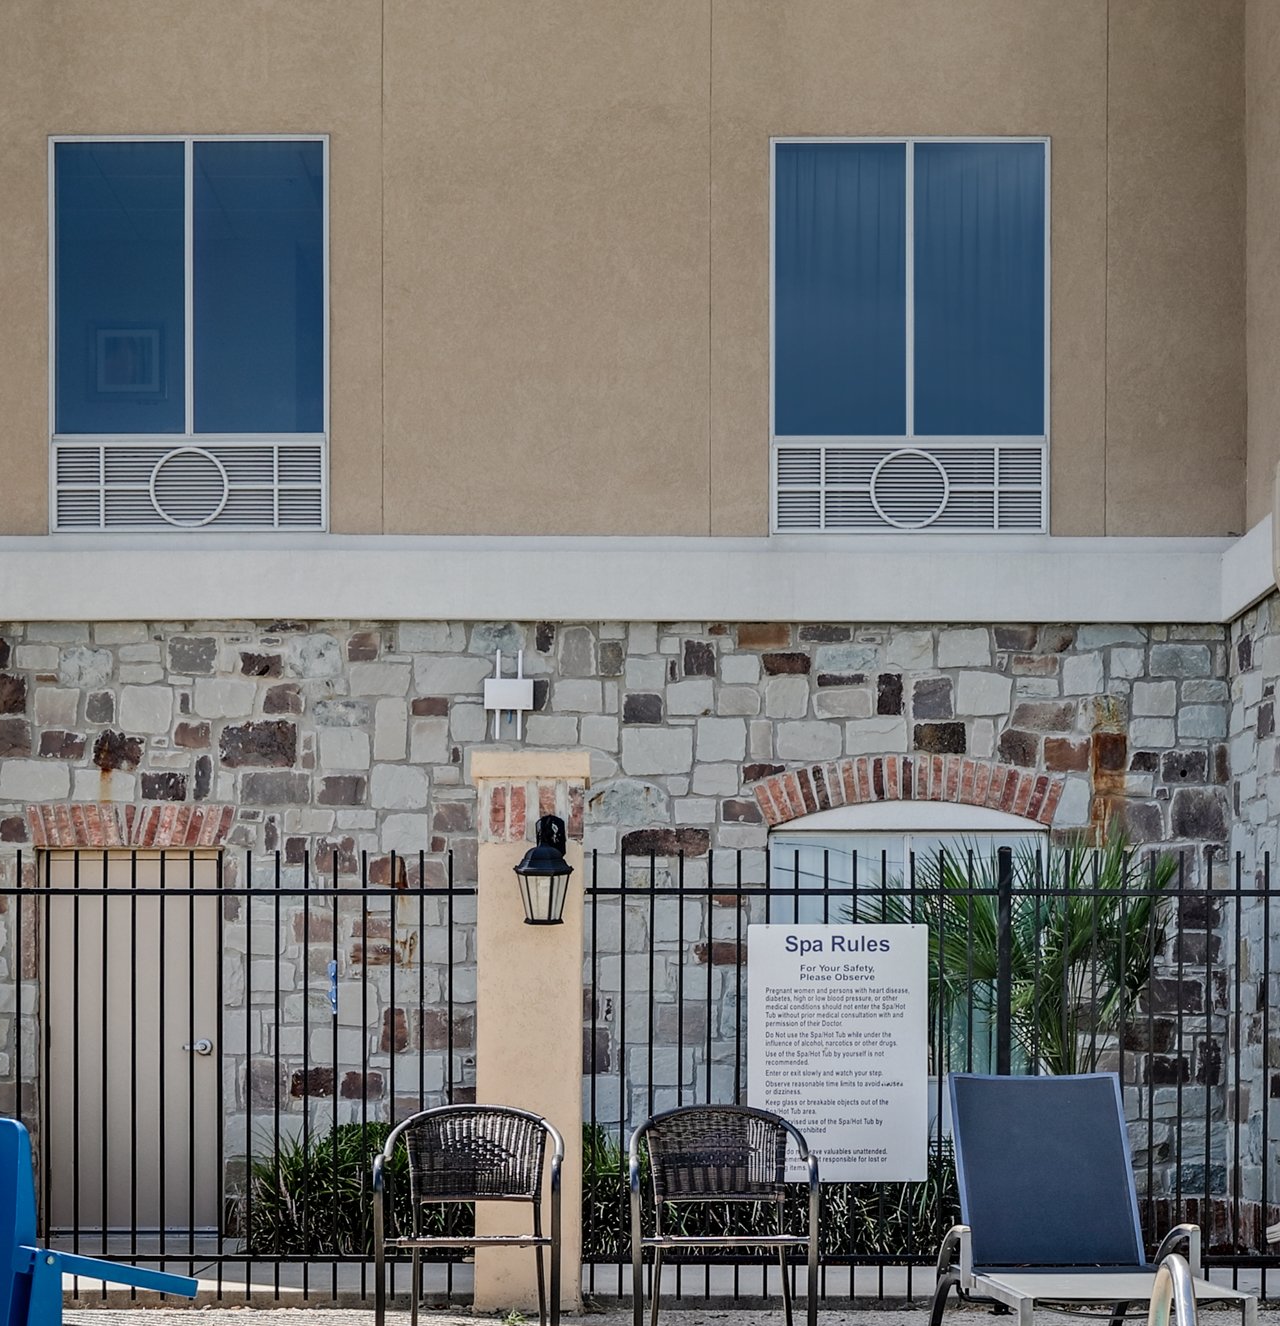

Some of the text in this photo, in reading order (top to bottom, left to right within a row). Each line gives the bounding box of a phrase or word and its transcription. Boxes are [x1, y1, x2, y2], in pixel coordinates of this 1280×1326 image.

[785, 935, 890, 956] Spa Rules
[800, 964, 874, 973] For Your Safety,
[765, 987, 792, 995] Pregnant
[765, 995, 792, 1003] diabetes,
[793, 995, 807, 1003] high
[882, 995, 898, 1003] other
[882, 1003, 906, 1011] Spa/Hot
[801, 1012, 815, 1020] prior
[765, 1020, 799, 1028] permission
[810, 1031, 834, 1039] Spa/Hot
[879, 1040, 898, 1048] drugs.
[796, 1050, 820, 1058] Spa/Hot
[834, 1050, 841, 1059] by
[842, 1050, 866, 1058] yourself
[802, 1070, 821, 1078] slowly
[765, 1099, 781, 1107] Keep
[782, 1099, 798, 1107] glass
[837, 1099, 859, 1107] objects
[819, 1118, 826, 1126] of
[838, 1118, 862, 1126] Spa/Hot
[875, 1118, 883, 1126] by
